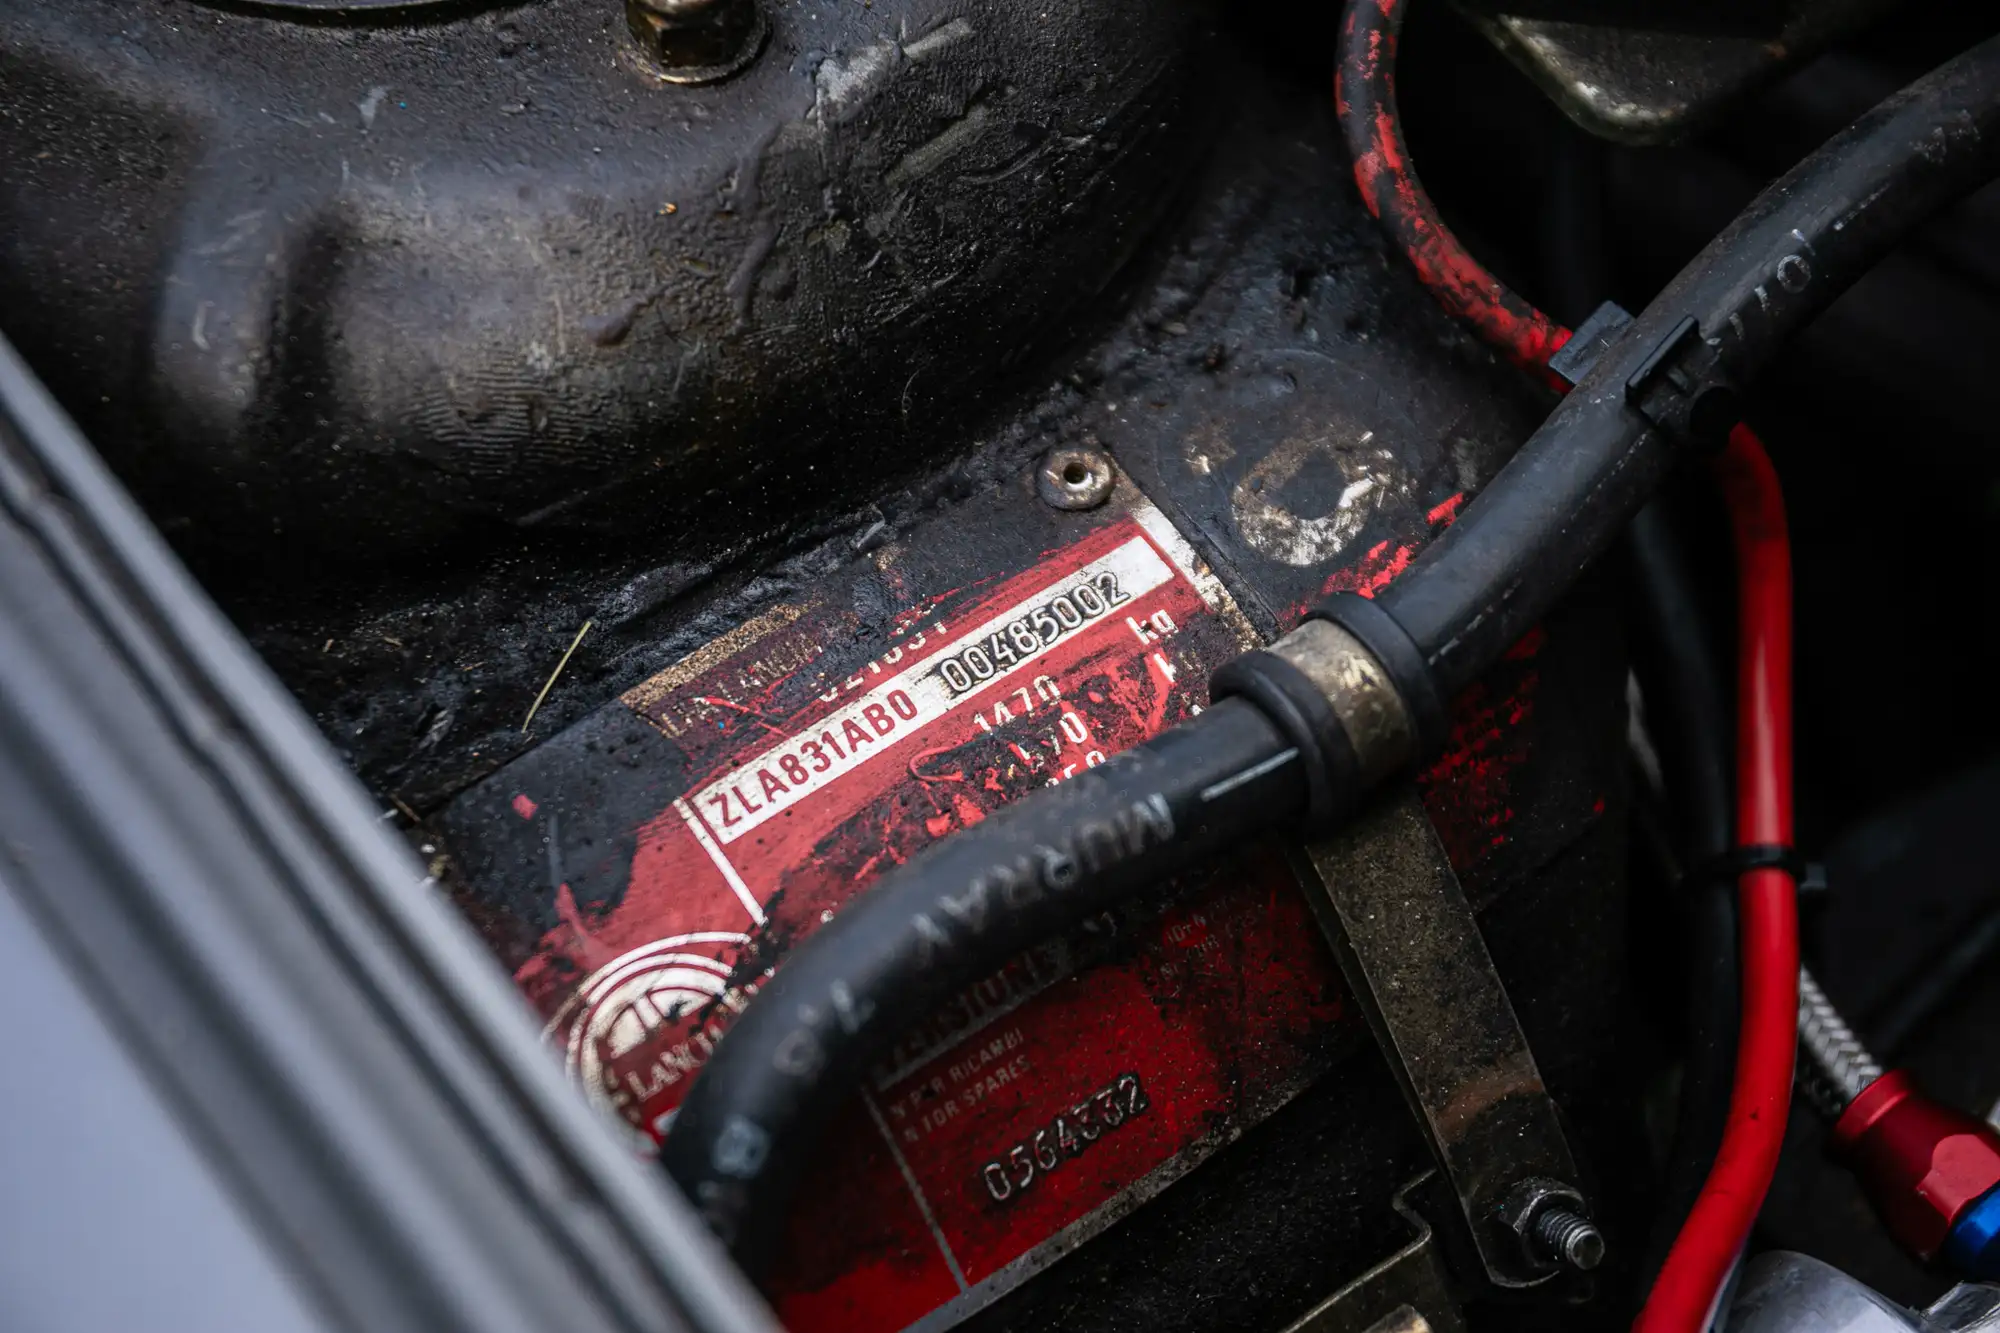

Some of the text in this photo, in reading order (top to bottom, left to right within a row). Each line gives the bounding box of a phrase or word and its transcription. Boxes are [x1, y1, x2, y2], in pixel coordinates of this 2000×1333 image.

[941, 571, 1131, 693] 00485002
[974, 674, 1061, 733] 1470
[949, 1028, 1025, 1083] RICAMBI
